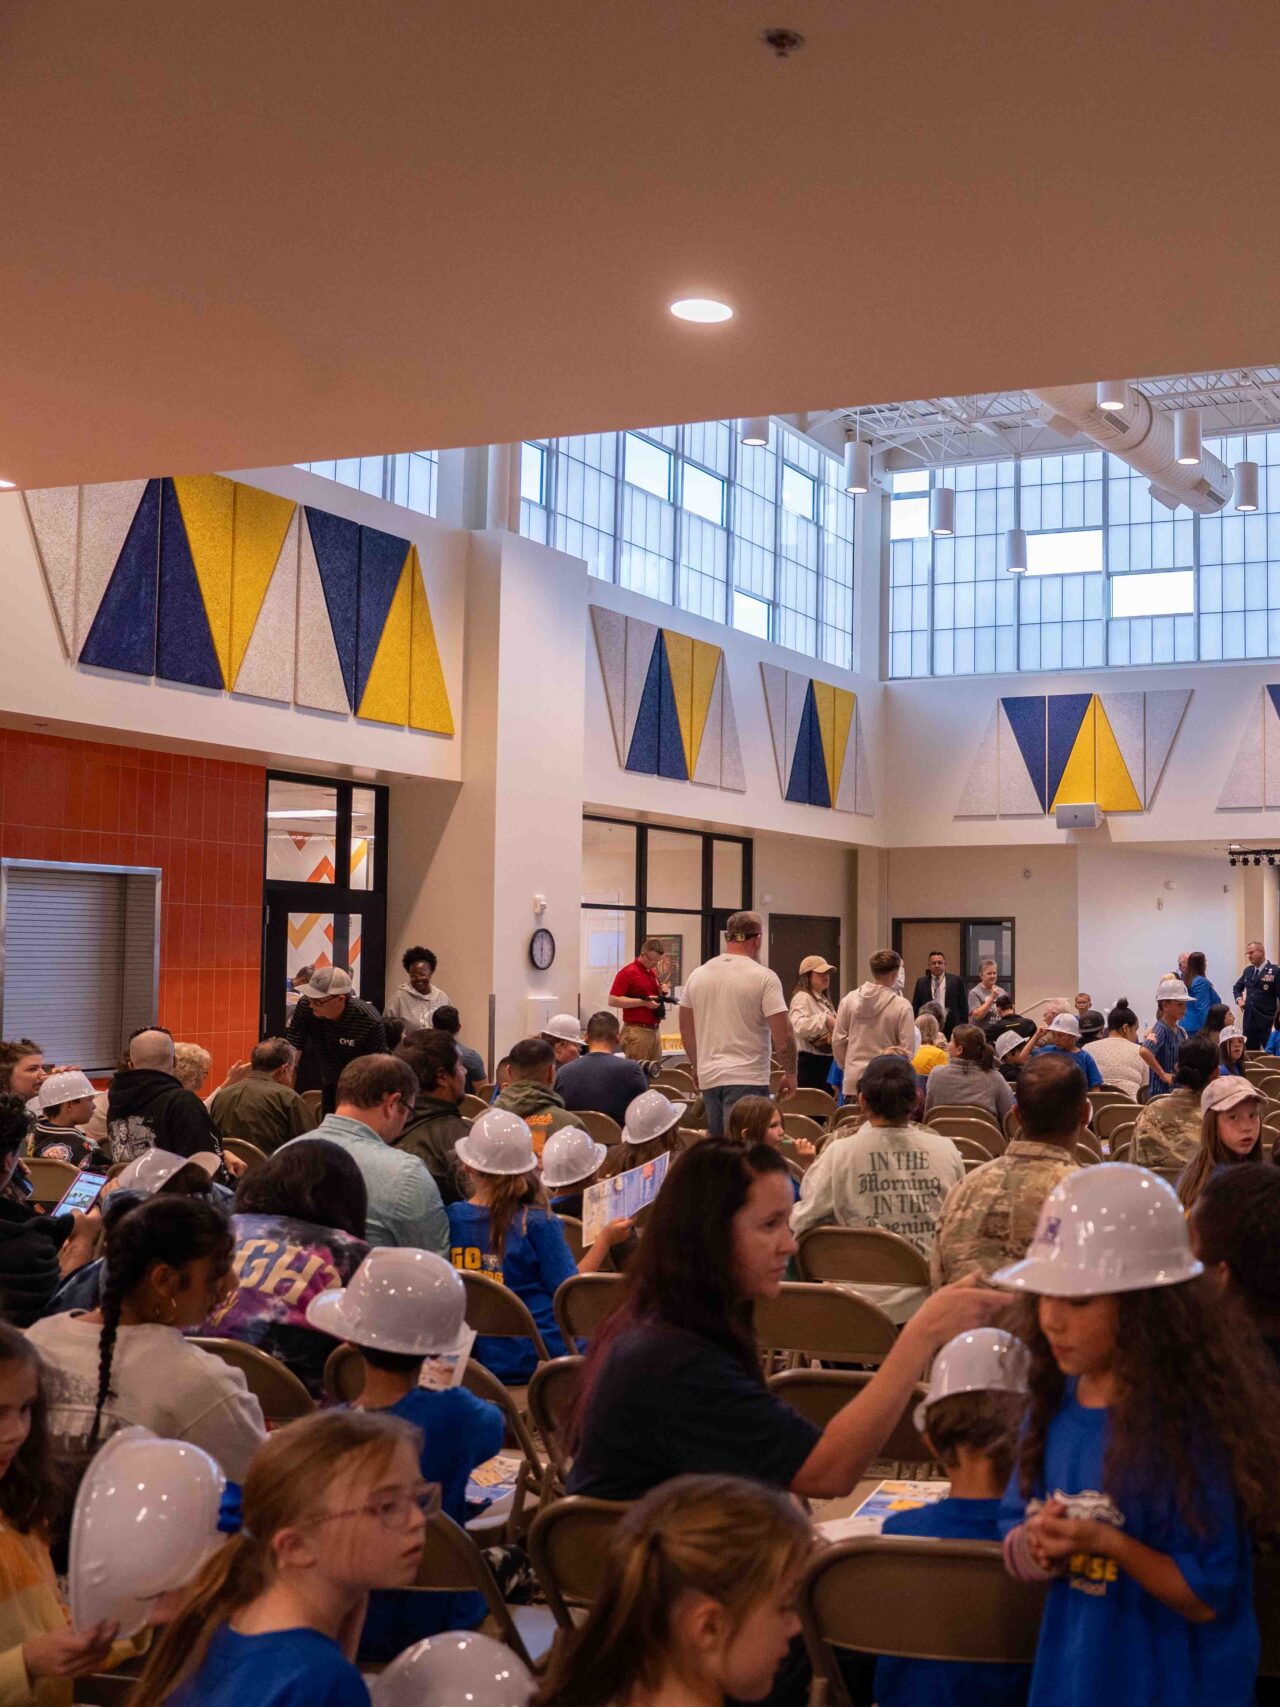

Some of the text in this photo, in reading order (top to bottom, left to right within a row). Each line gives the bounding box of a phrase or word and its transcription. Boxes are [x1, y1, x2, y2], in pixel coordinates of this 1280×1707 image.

[869, 1151, 930, 1172] IN THE
[858, 1172, 941, 1198] Morning
[873, 1193, 932, 1216] IN THE
